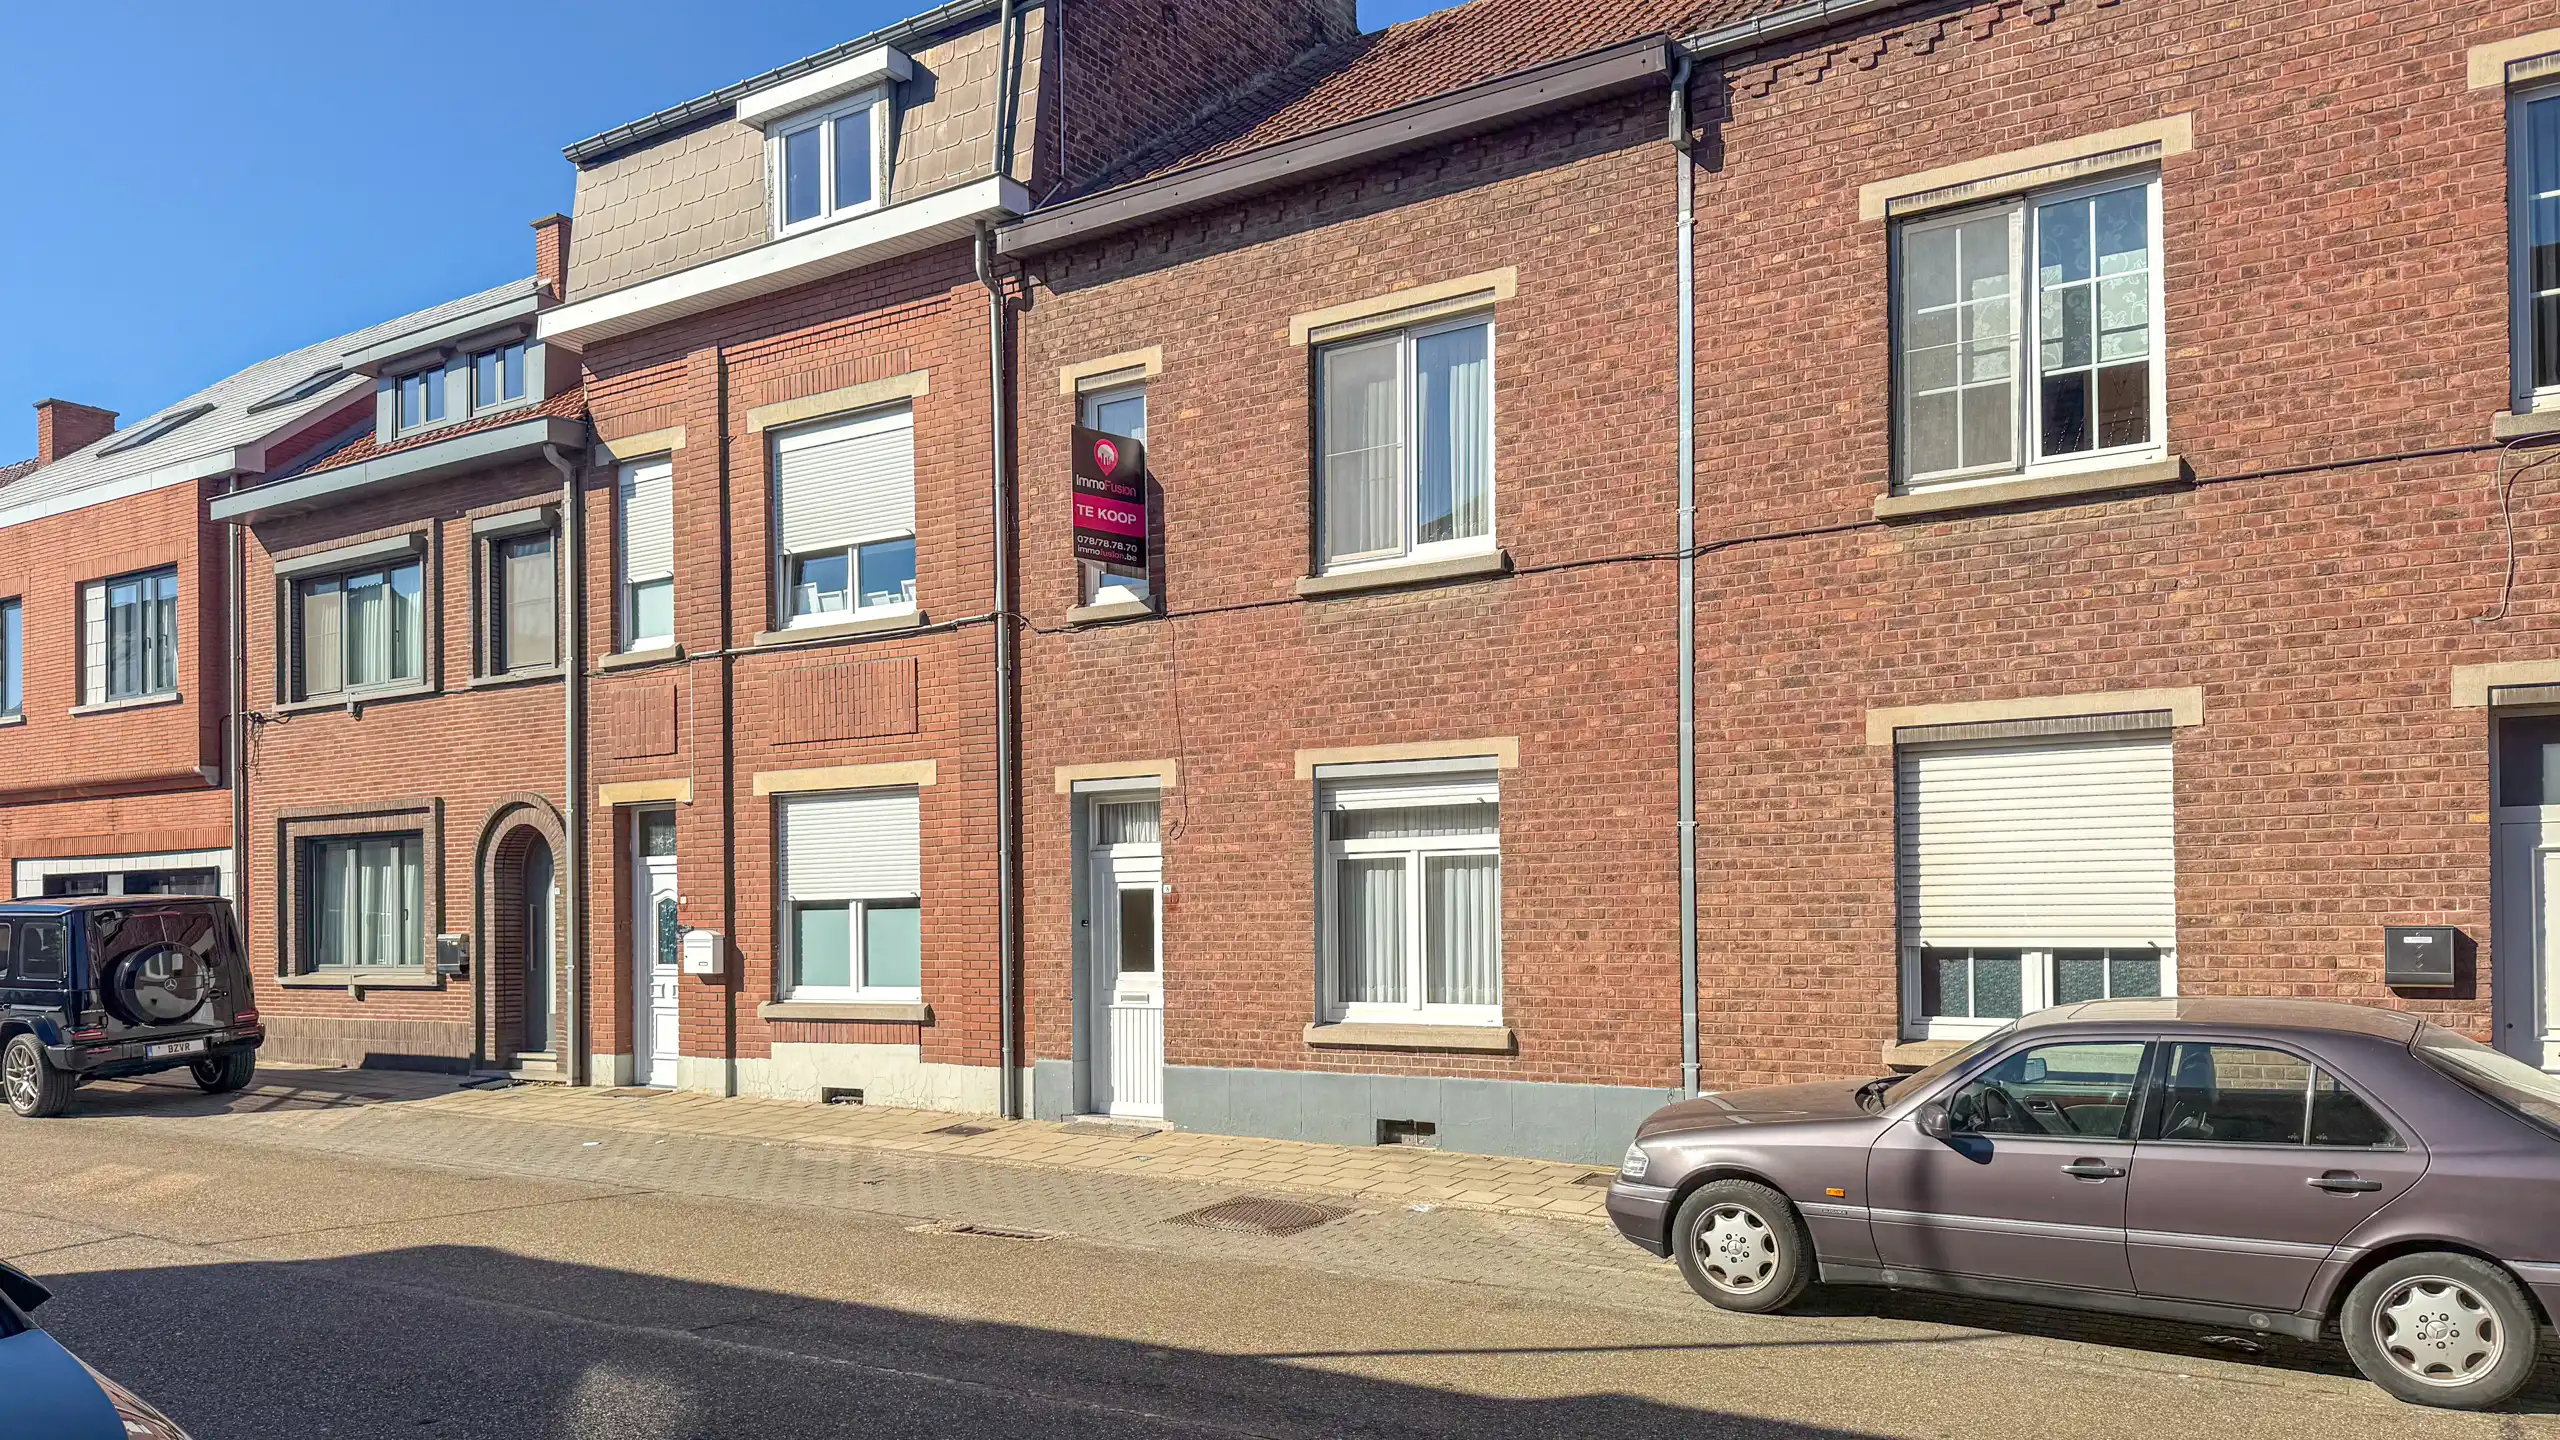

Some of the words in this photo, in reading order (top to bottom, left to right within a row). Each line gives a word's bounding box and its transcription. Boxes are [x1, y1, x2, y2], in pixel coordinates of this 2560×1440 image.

[1076, 474, 1136, 497] ImmoFusion
[1076, 504, 1094, 517] TE
[1098, 508, 1137, 525] KOOP
[1077, 535, 1138, 553] 078/78.78.70
[1077, 545, 1138, 562] immofusion.be
